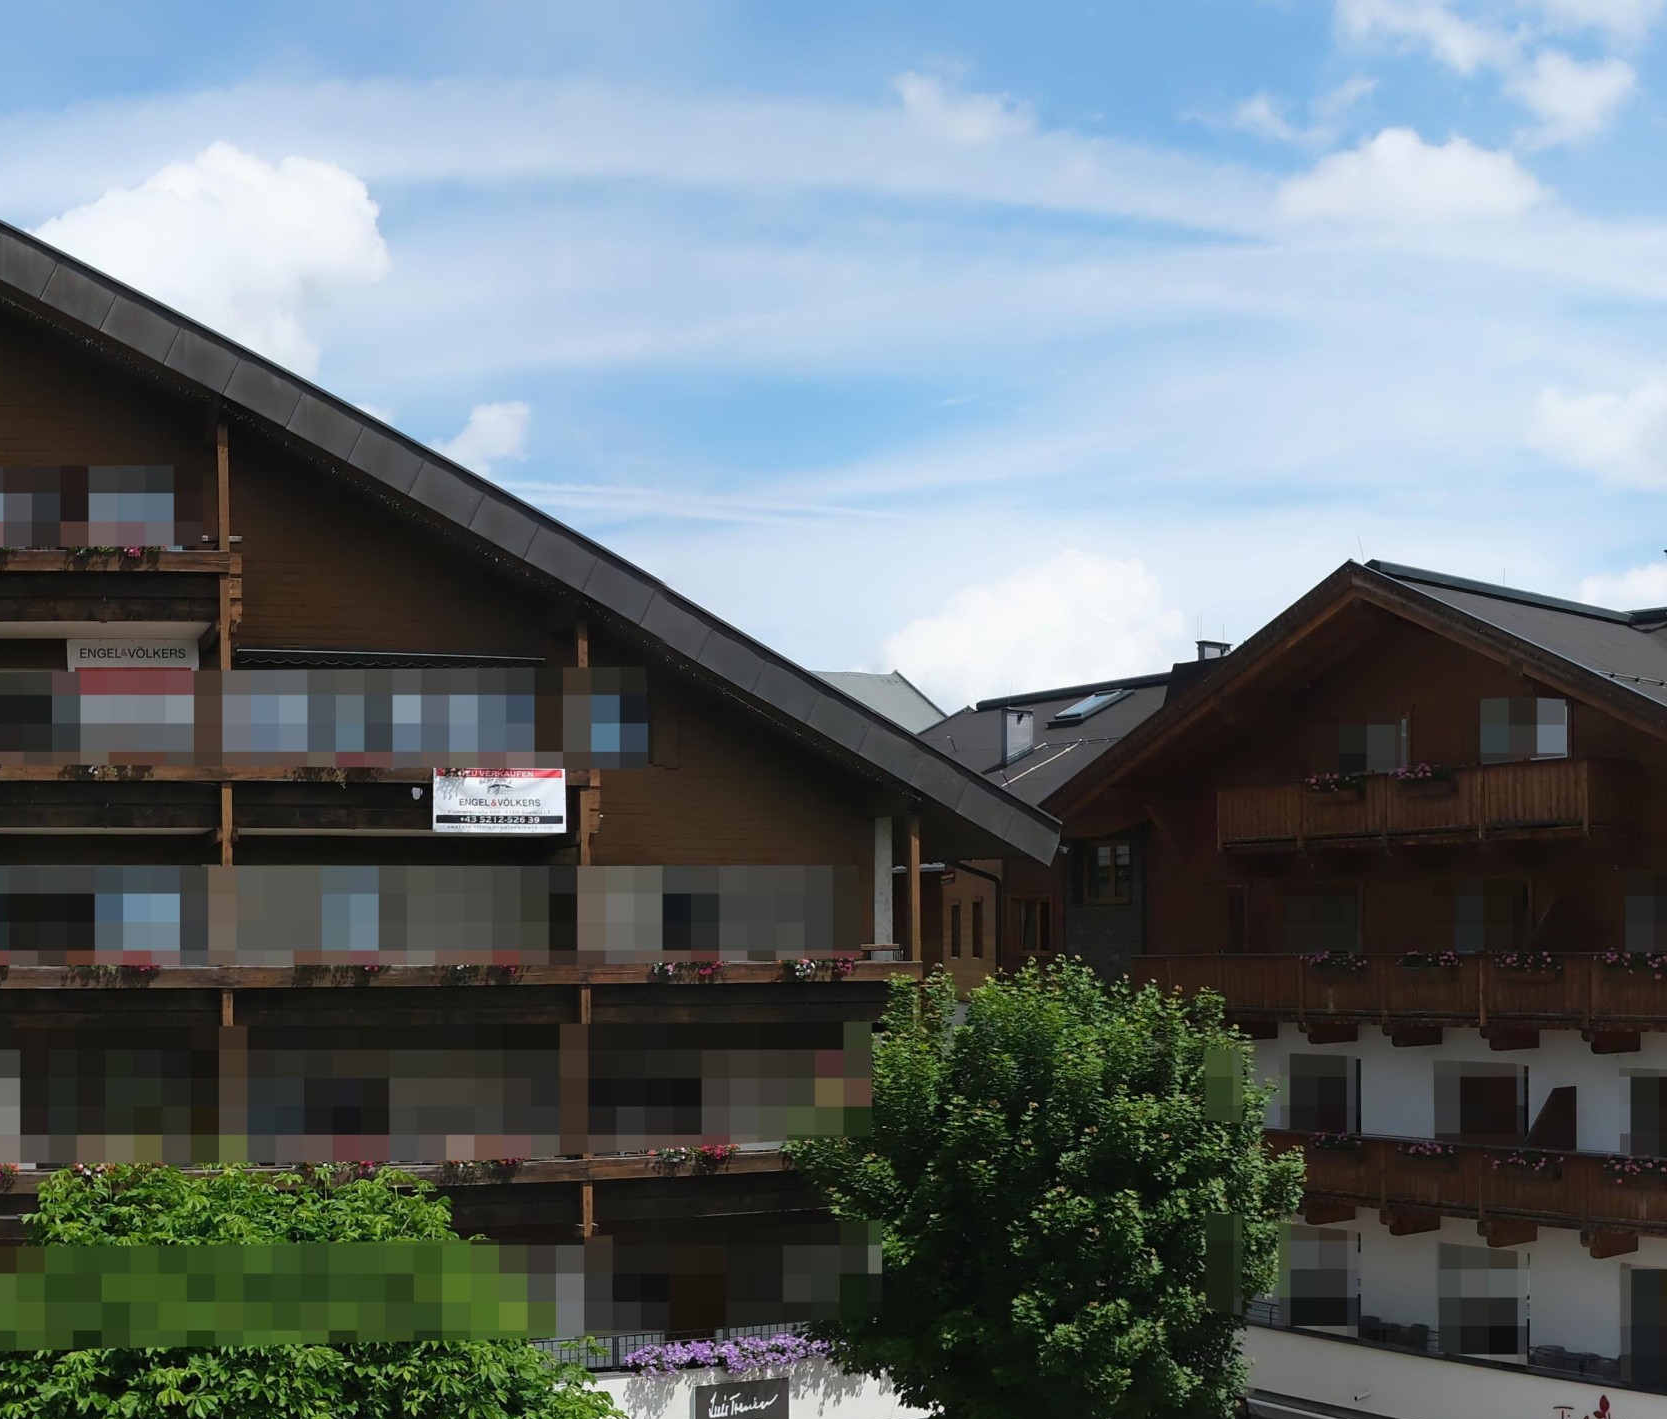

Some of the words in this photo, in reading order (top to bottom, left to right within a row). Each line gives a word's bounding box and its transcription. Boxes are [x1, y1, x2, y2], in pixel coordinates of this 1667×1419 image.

[480, 769, 534, 778] VERKAUFEN
[479, 816, 526, 824] 5212-526
[527, 816, 540, 824] 39
